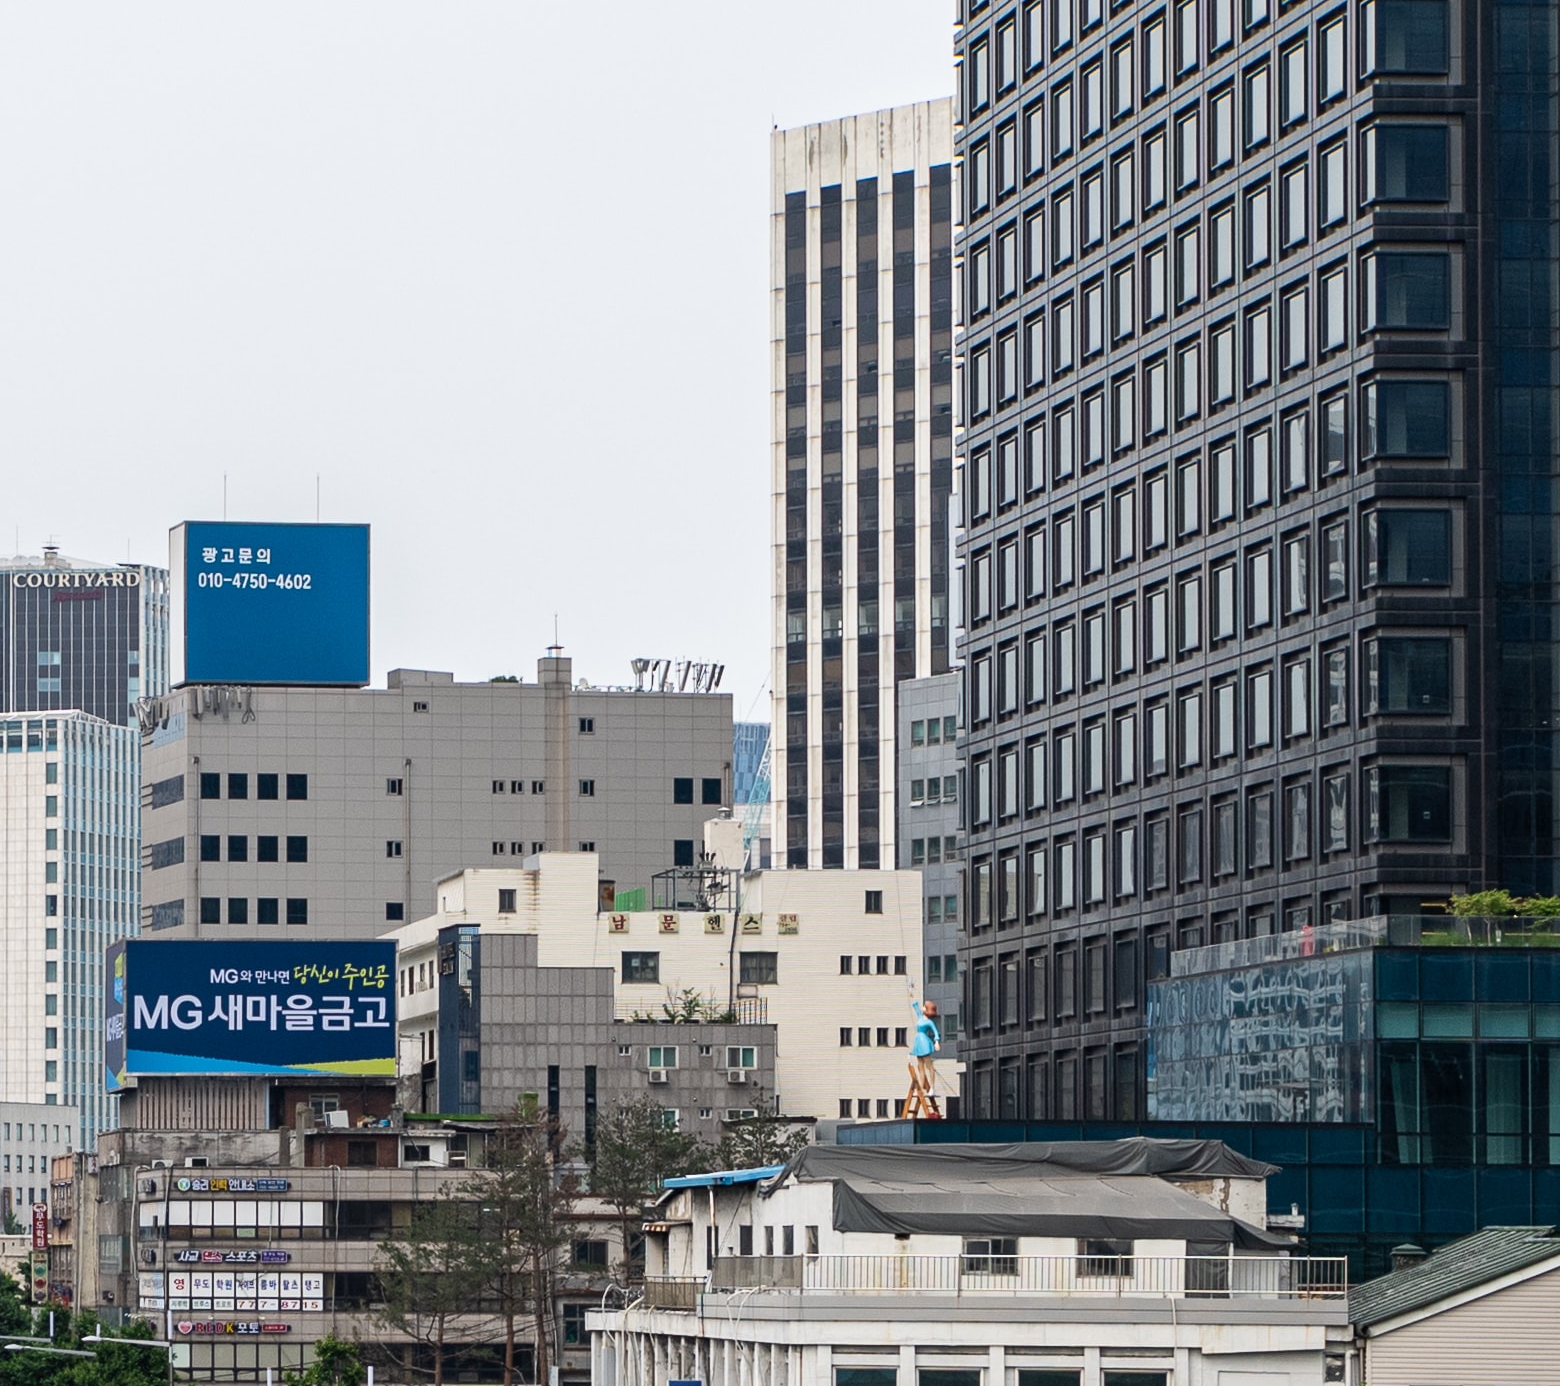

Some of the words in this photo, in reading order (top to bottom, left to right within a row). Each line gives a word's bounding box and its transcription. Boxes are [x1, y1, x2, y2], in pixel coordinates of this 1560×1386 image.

[201, 547, 271, 565] 광고문의
[12, 571, 141, 588] COURTYARD
[197, 572, 312, 590] 010-4750-4602
[254, 969, 290, 985] 만나면
[292, 964, 339, 986] 당신이
[341, 962, 389, 991] 주인공
[178, 1249, 200, 1262] 사교
[225, 1249, 258, 1263] 스포츠
[193, 1280, 210, 1291] 무도
[215, 1280, 233, 1291] 학원
[237, 1322, 260, 1333] 포토
